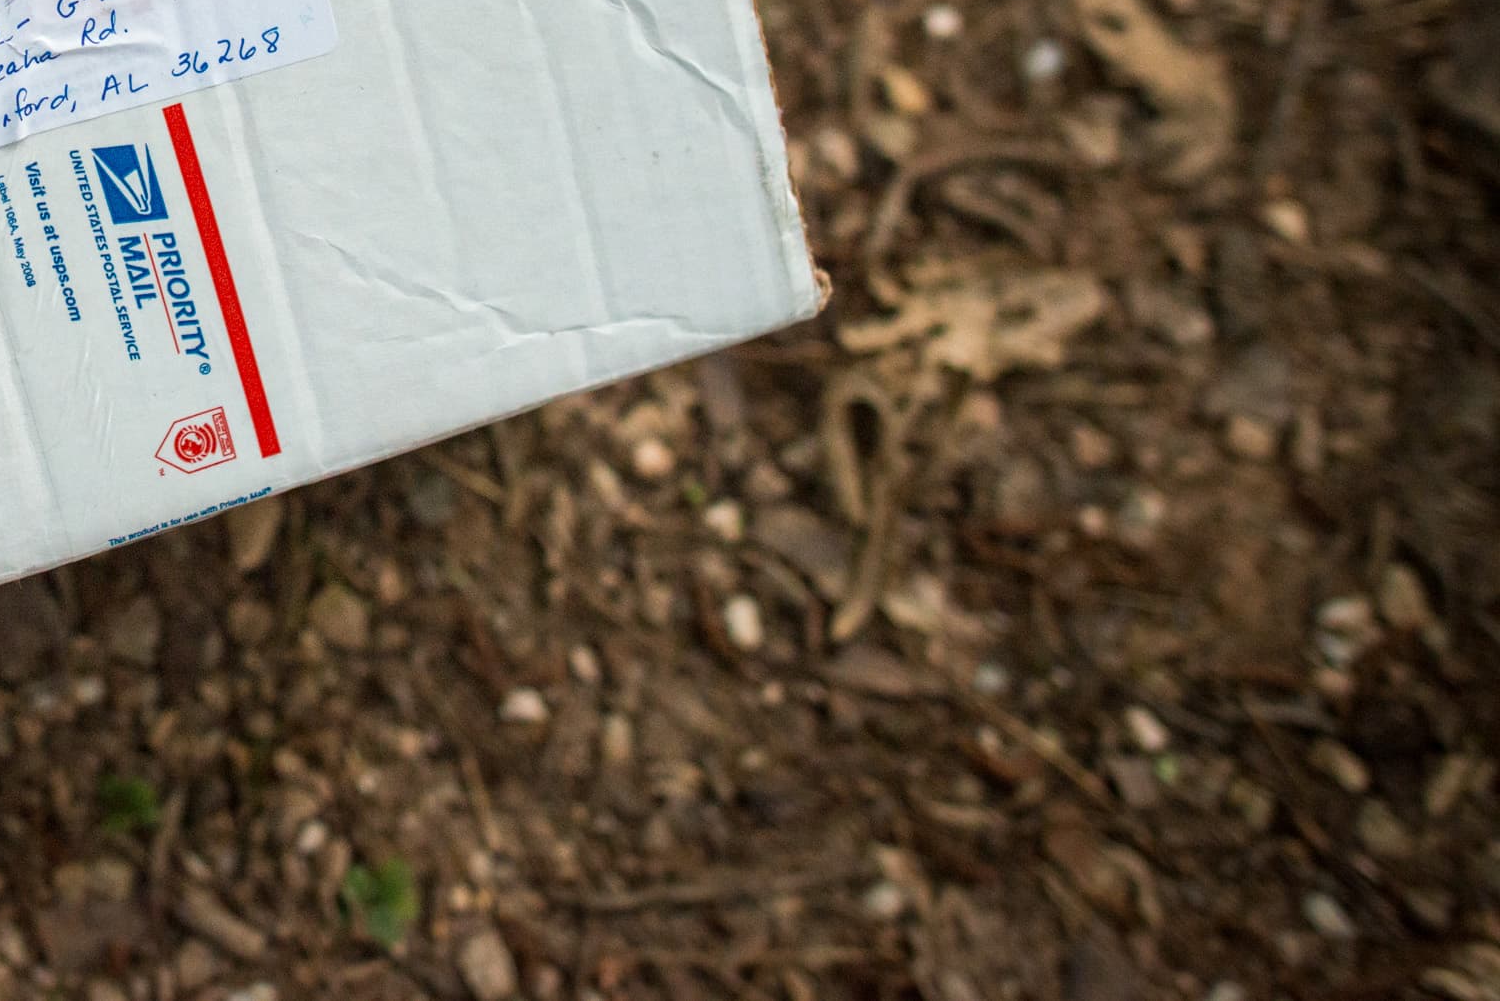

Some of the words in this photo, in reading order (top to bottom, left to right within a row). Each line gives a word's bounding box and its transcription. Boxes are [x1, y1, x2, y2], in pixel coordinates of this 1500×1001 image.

[81, 9, 128, 45] Rd.
[101, 72, 148, 101] AL
[172, 26, 279, 79] 36268
[25, 161, 45, 198] Visit
[37, 202, 51, 221] us
[3, 206, 17, 236] 106A,
[12, 237, 27, 259] May
[21, 260, 37, 288] 2008
[44, 225, 60, 242] at
[69, 150, 94, 201] UNITED
[85, 202, 108, 252] STATES
[101, 254, 124, 305] POSTAL
[115, 307, 141, 361] SERVICE
[50, 244, 82, 322] usps.com
[117, 235, 157, 309] MAIL
